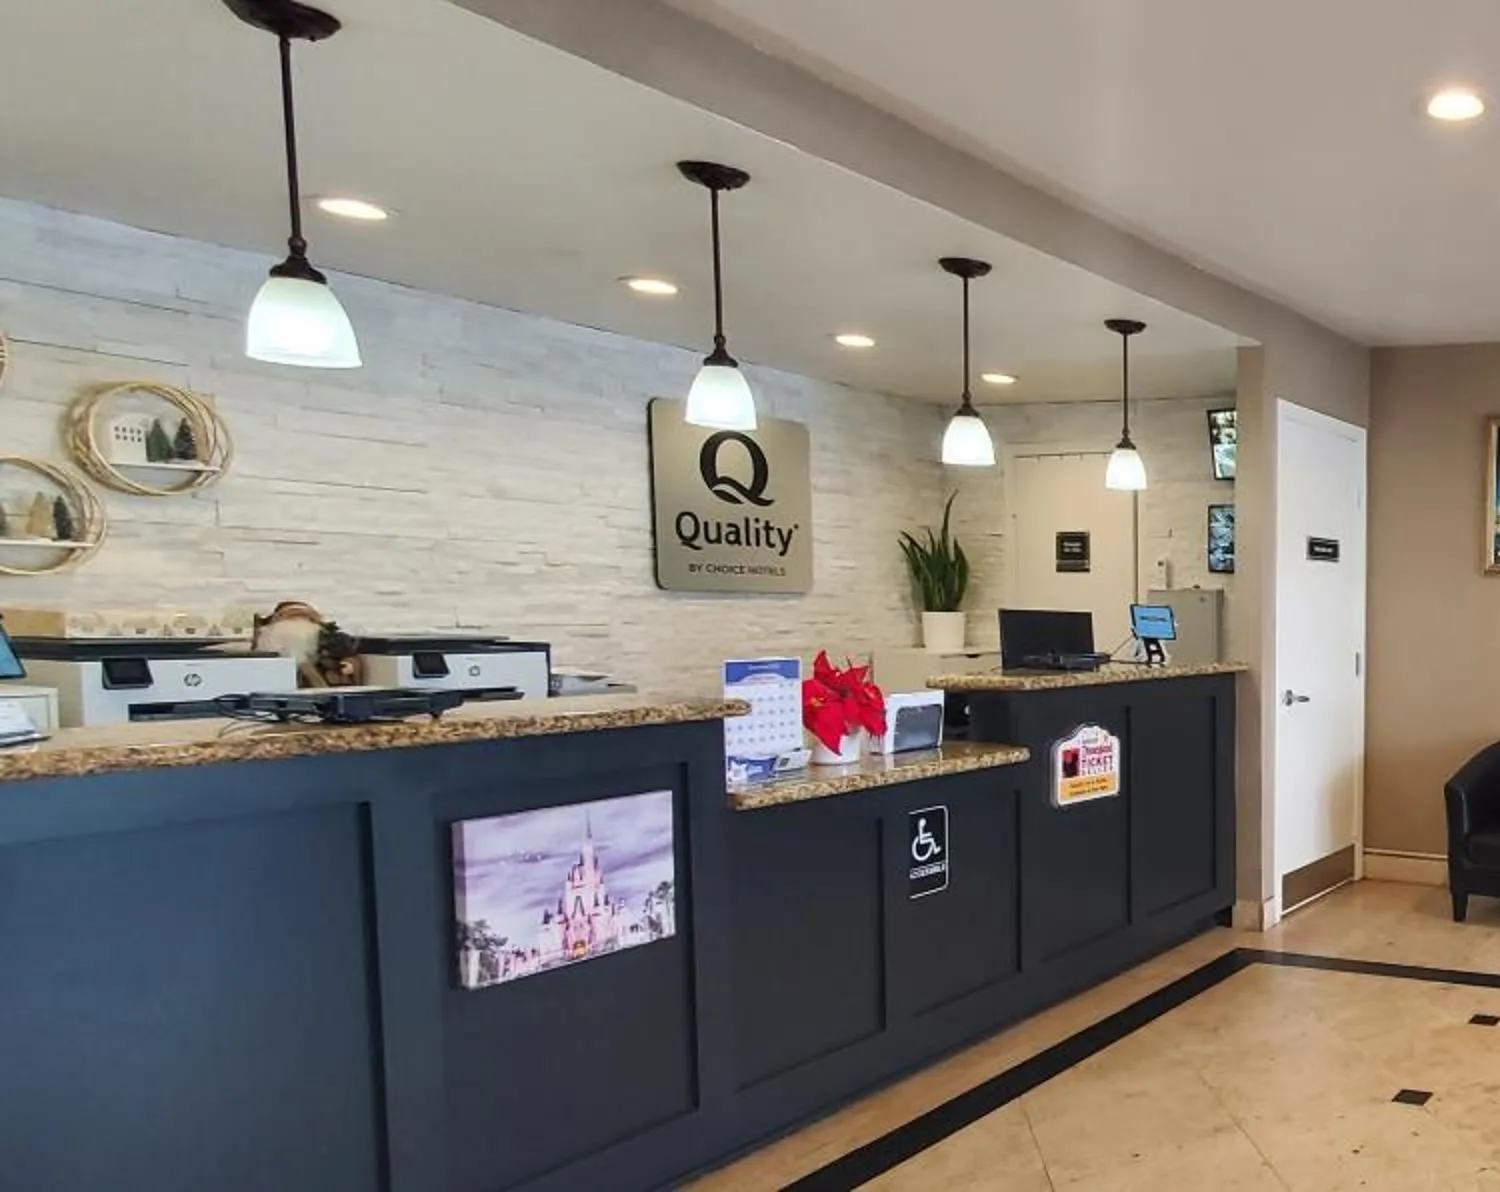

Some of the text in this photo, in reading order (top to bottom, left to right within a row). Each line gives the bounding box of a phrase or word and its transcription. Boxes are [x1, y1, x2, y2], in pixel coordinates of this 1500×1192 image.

[700, 430, 775, 507] Q
[675, 511, 793, 556] Quality
[688, 563, 786, 576] BY CHOICE HOTELS
